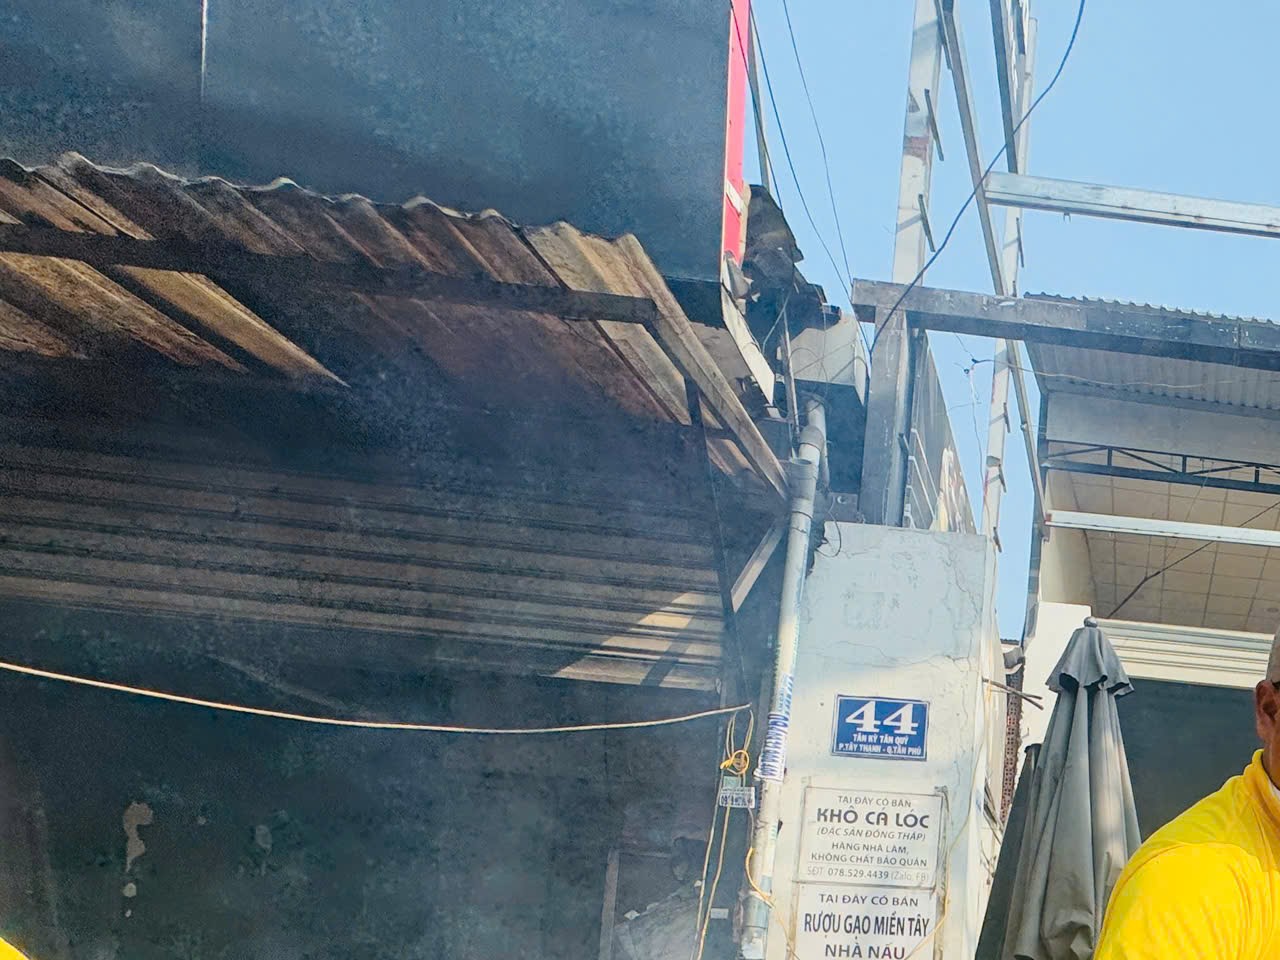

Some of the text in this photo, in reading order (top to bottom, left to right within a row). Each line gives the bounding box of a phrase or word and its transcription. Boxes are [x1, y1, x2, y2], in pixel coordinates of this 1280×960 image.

[845, 700, 919, 735] 44
[817, 805, 930, 829] KHÔ CÁ LÓC
[811, 852, 847, 863] KHÔNG
[827, 867, 889, 880] 078.529.4439
[804, 911, 841, 939] RƯỢU
[844, 914, 871, 940] GẠO
[908, 913, 930, 937] TÂY
[825, 941, 905, 960] NHÀ NẤU
